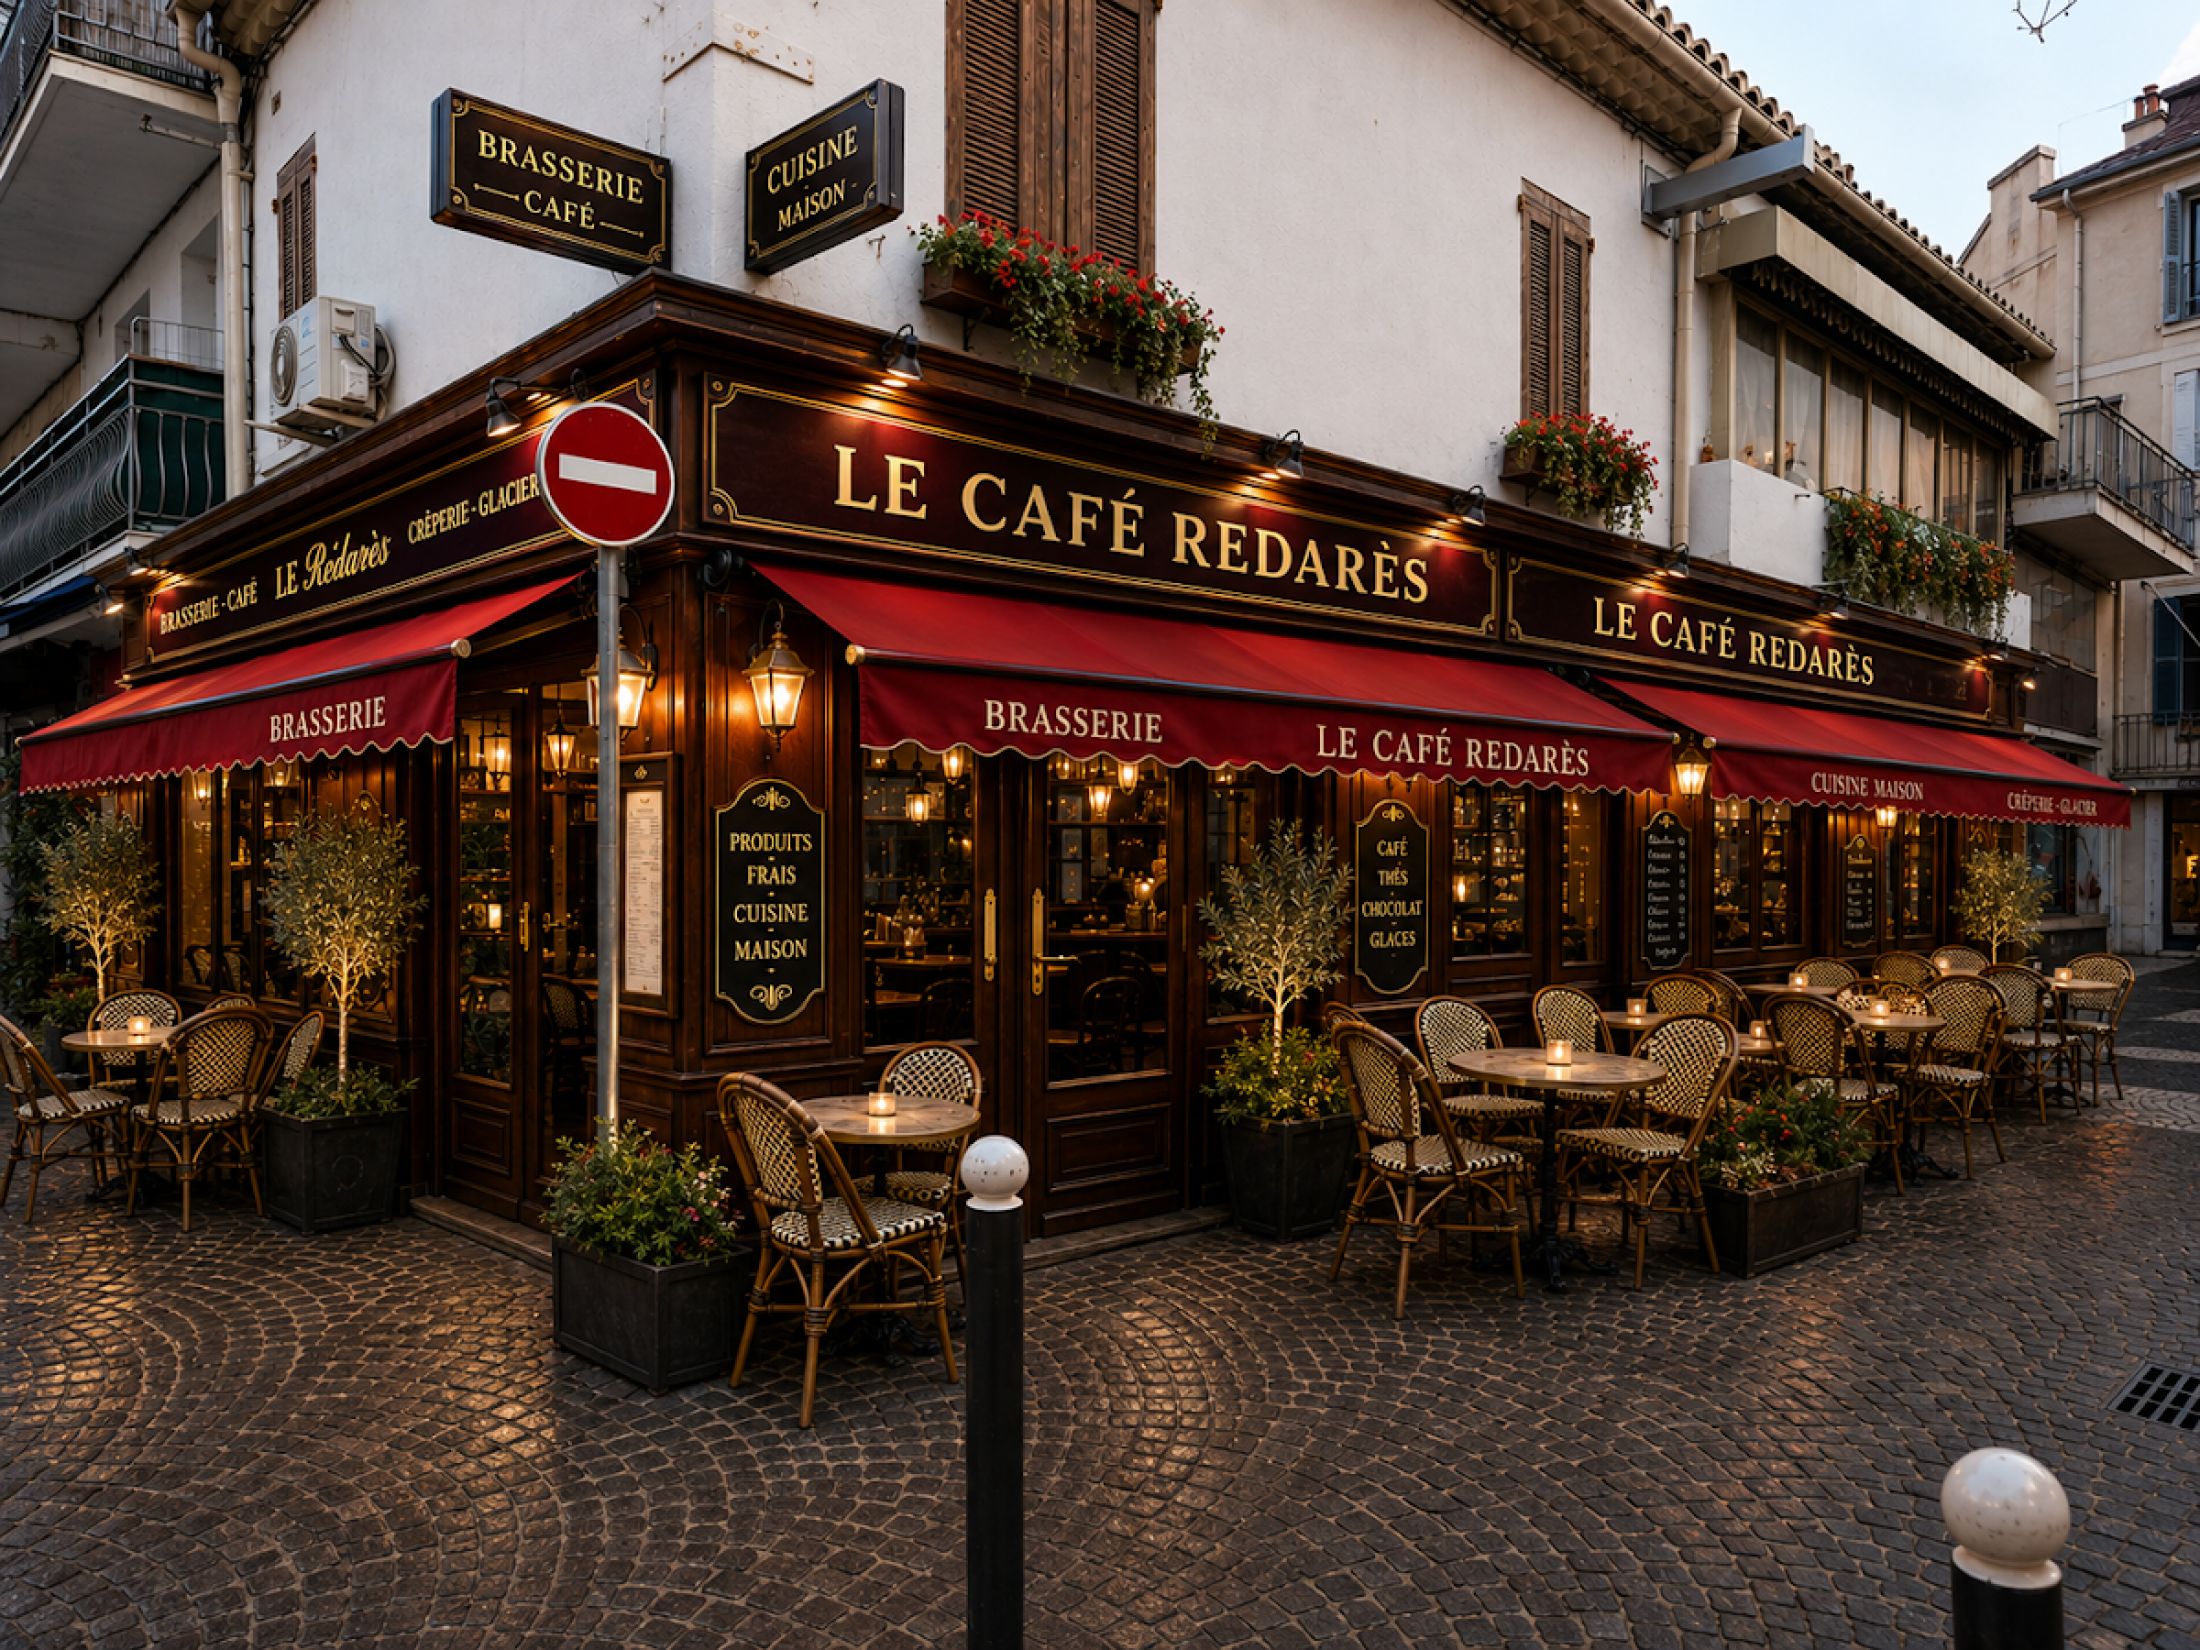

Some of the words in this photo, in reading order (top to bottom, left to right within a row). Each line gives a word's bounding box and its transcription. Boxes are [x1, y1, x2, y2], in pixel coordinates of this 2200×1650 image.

[478, 129, 644, 204] BRASSERIE
[767, 125, 859, 195] CUISINE
[523, 189, 595, 230] CAFÉ
[833, 443, 927, 520] LE
[960, 471, 1146, 557] CAFÉ
[1172, 510, 1430, 604] REDARÈS
[160, 595, 220, 635] BRASSERIE
[226, 575, 258, 612] CAFÉ
[274, 559, 299, 600] LE
[478, 472, 540, 518] GLACIER
[1593, 596, 1638, 641] LE
[1650, 610, 1737, 660] CAFÉ
[1748, 630, 1875, 687] REDARÈS
[269, 695, 386, 743] BRASSERIE
[984, 698, 1163, 744] BRASSERIE
[1316, 723, 1358, 760] LE
[1372, 727, 1453, 767] CAFÉ
[1465, 738, 1590, 777] REDARÈS
[1811, 771, 1869, 797] CUISINE
[1873, 778, 1924, 800] MAISON
[729, 832, 813, 852] PRODUITS
[1376, 836, 1409, 857] CAFÉ
[747, 865, 797, 886] FRAIS
[733, 903, 809, 924] CUISINE
[1361, 900, 1423, 918] CHOCOLAT
[734, 938, 809, 962] MAISON
[1369, 931, 1416, 949] GLACES
